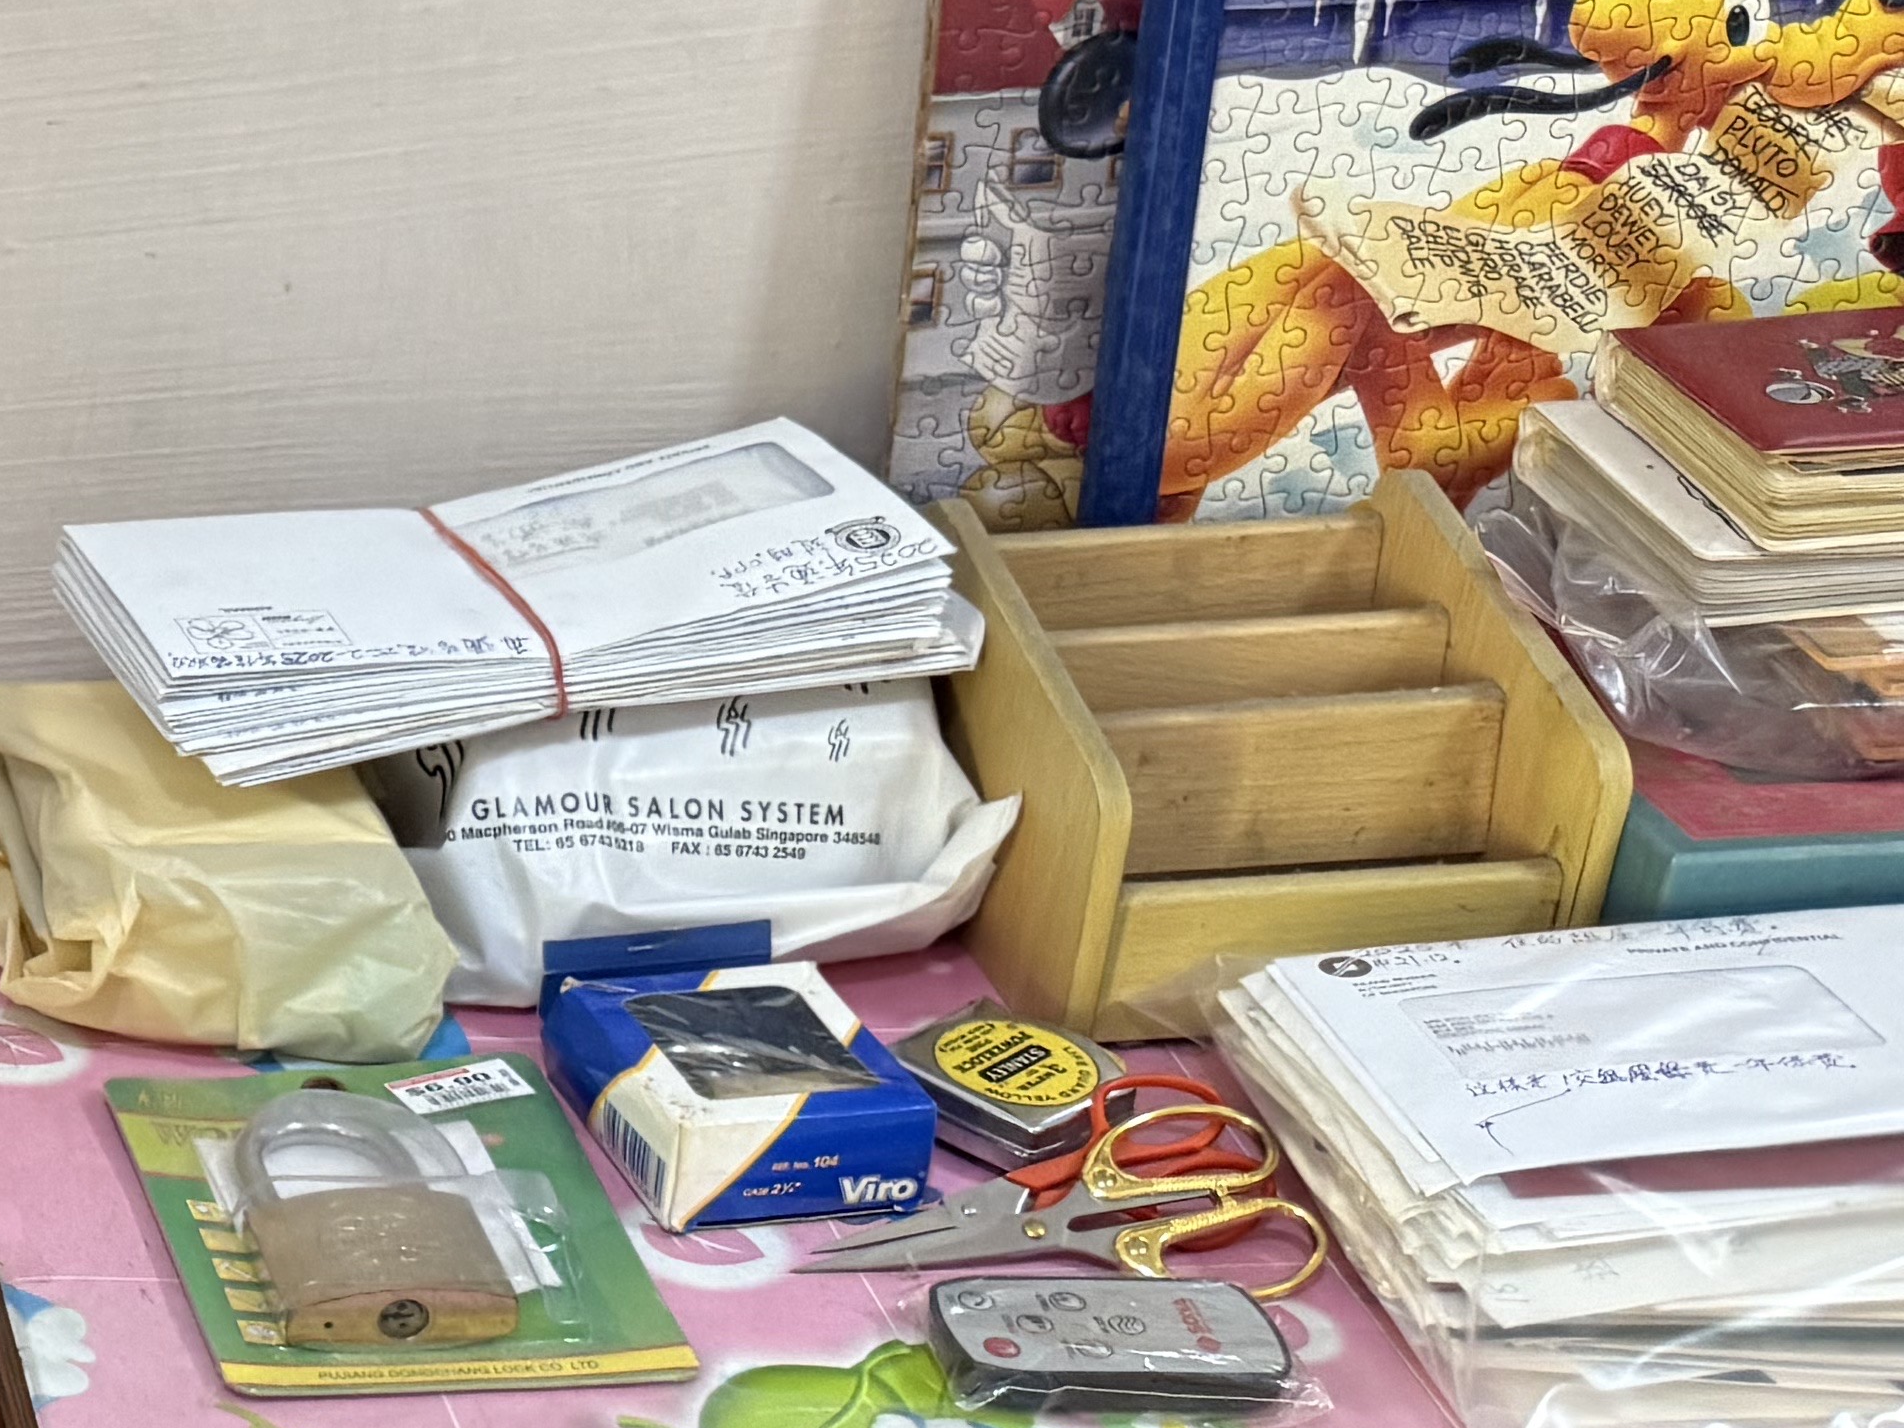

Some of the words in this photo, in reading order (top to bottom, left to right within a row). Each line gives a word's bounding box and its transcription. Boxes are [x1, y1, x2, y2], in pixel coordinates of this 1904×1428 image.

[1726, 115, 1799, 178] PLUTO
[1618, 175, 1676, 226] HUEY
[1674, 161, 1749, 215] DAISY
[1705, 145, 1786, 218] DONALD
[1390, 215, 1436, 270] DALE
[1418, 220, 1455, 268] CHIP
[1581, 211, 1651, 269] LOUEY
[1598, 193, 1666, 254] DEWEY
[1491, 238, 1546, 310] HORACE
[1539, 241, 1603, 306] FERDIE
[1561, 229, 1630, 287] MORTY
[460, 819, 560, 844] Macpherson
[563, 816, 604, 832] Road
[652, 821, 704, 839] Wisma
[708, 825, 752, 840] Gulab
[755, 827, 829, 847] Singapore
[470, 791, 614, 821] GLAMOUR
[628, 796, 726, 823] SALON
[739, 799, 846, 827] SYSTEM
[512, 837, 552, 854] TEL:
[985, 1045, 1047, 1083] STANLEY
[837, 1173, 919, 1205] Viro
